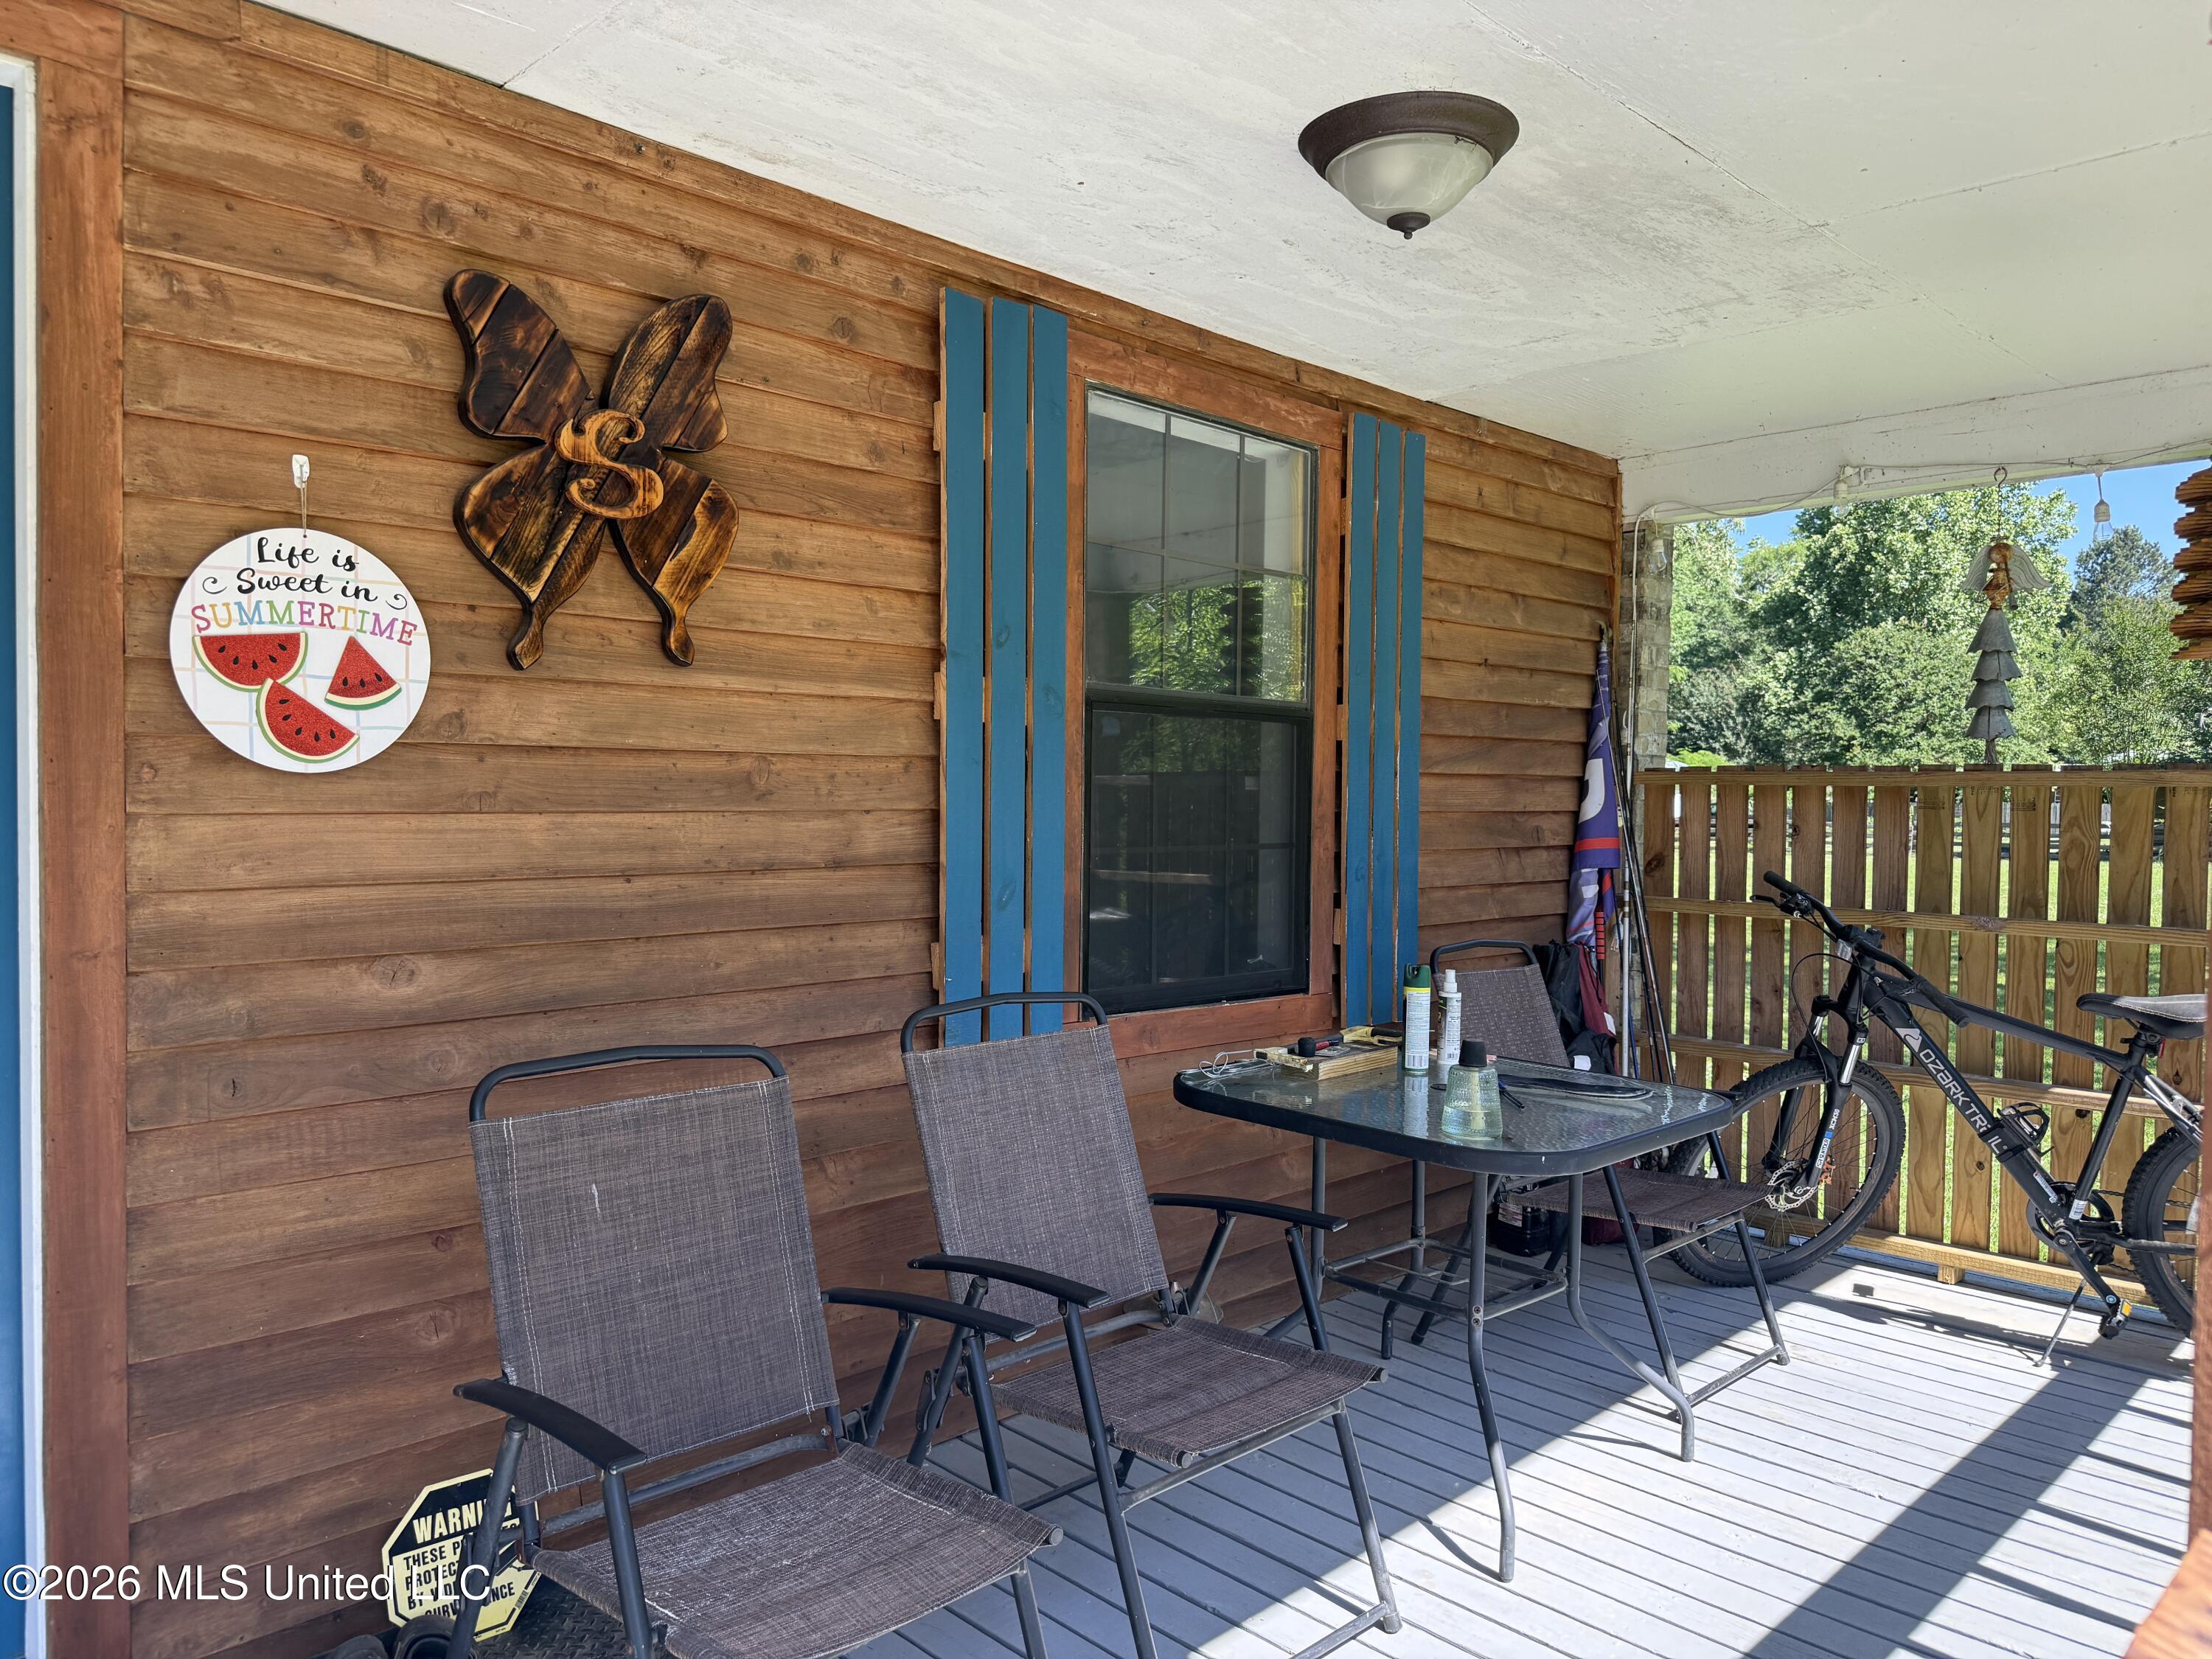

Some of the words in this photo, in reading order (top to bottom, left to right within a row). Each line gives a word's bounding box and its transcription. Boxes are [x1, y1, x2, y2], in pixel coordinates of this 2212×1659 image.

[257, 537, 319, 569] Life
[331, 549, 360, 572] is
[236, 567, 333, 594] Sweet
[341, 580, 378, 602] in
[191, 599, 418, 647] SUMMERTIME
[413, 1498, 512, 1544] WARNI
[403, 1545, 447, 1571] THESE
